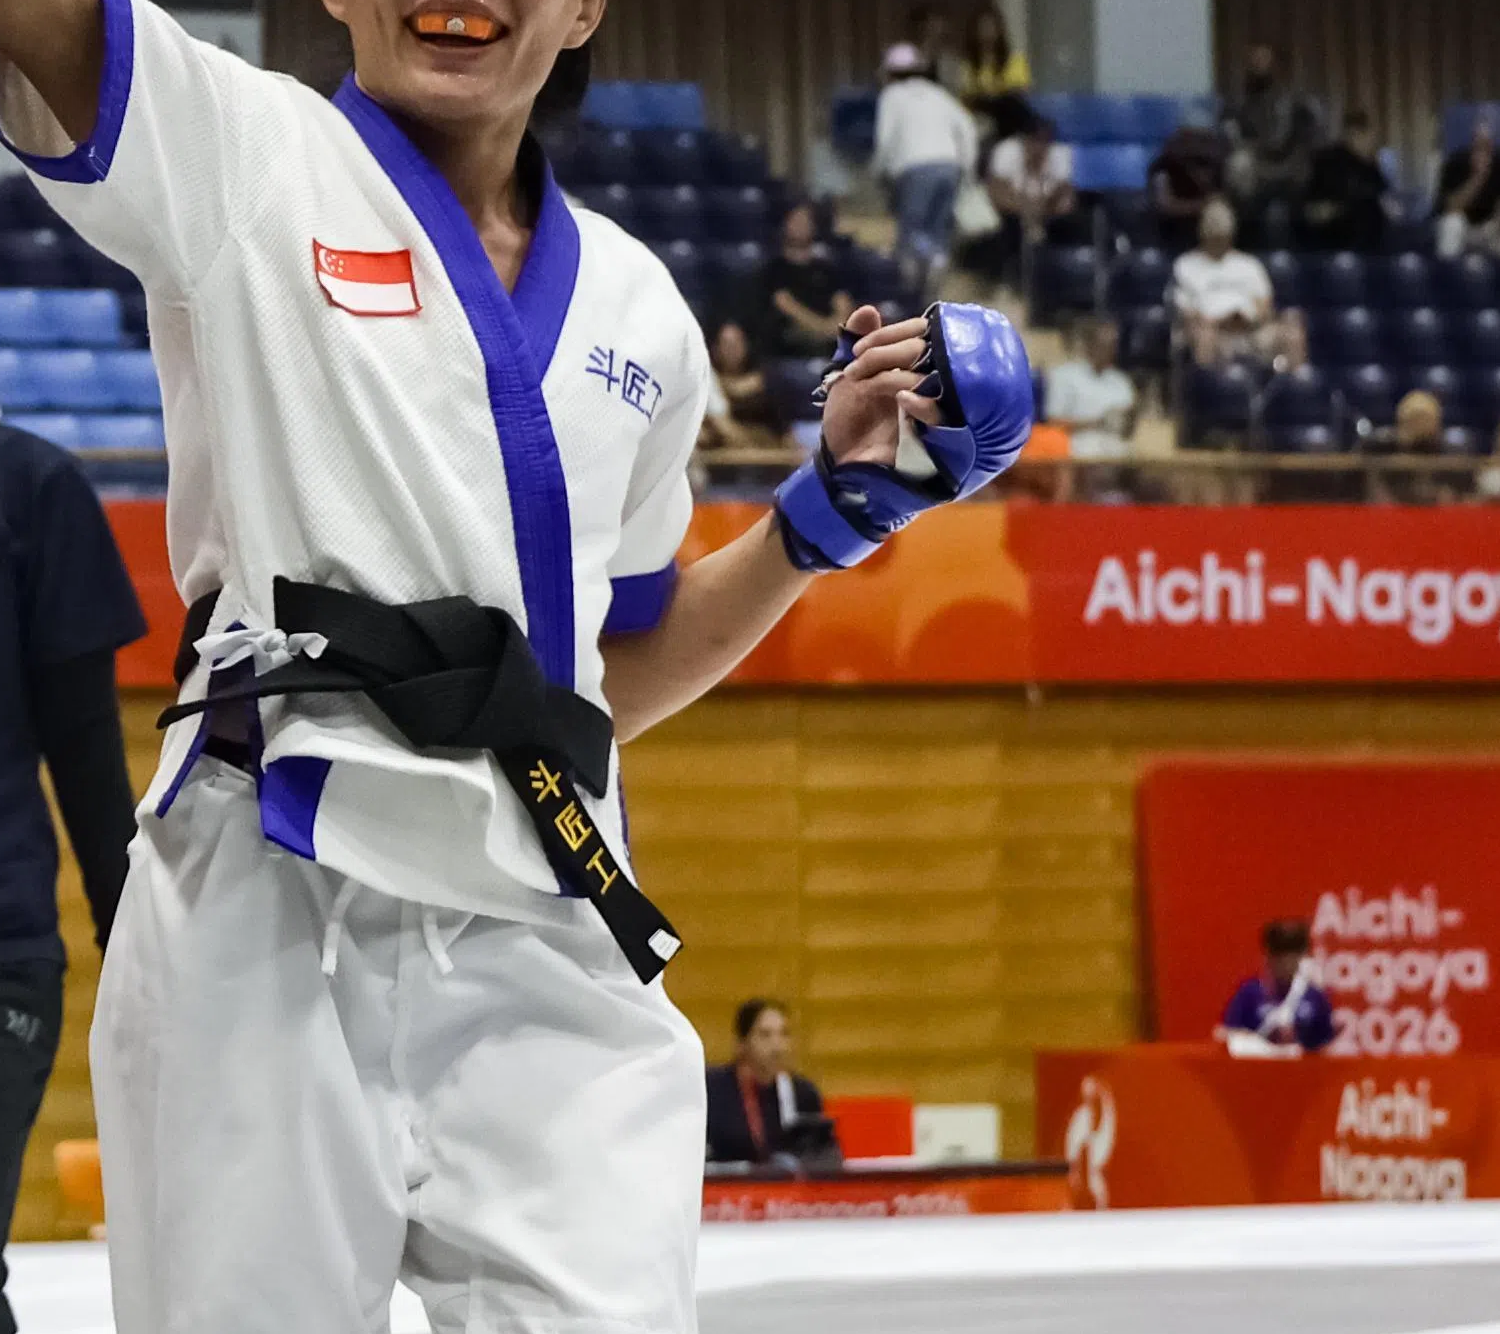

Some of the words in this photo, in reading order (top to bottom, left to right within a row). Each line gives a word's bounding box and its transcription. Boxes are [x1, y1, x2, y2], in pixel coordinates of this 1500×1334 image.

[529, 759, 618, 895] 斗匠工
[1311, 886, 1464, 939] Aichi-
[1325, 1006, 1462, 1058] 2026
[1336, 1078, 1450, 1140] Aichi-
